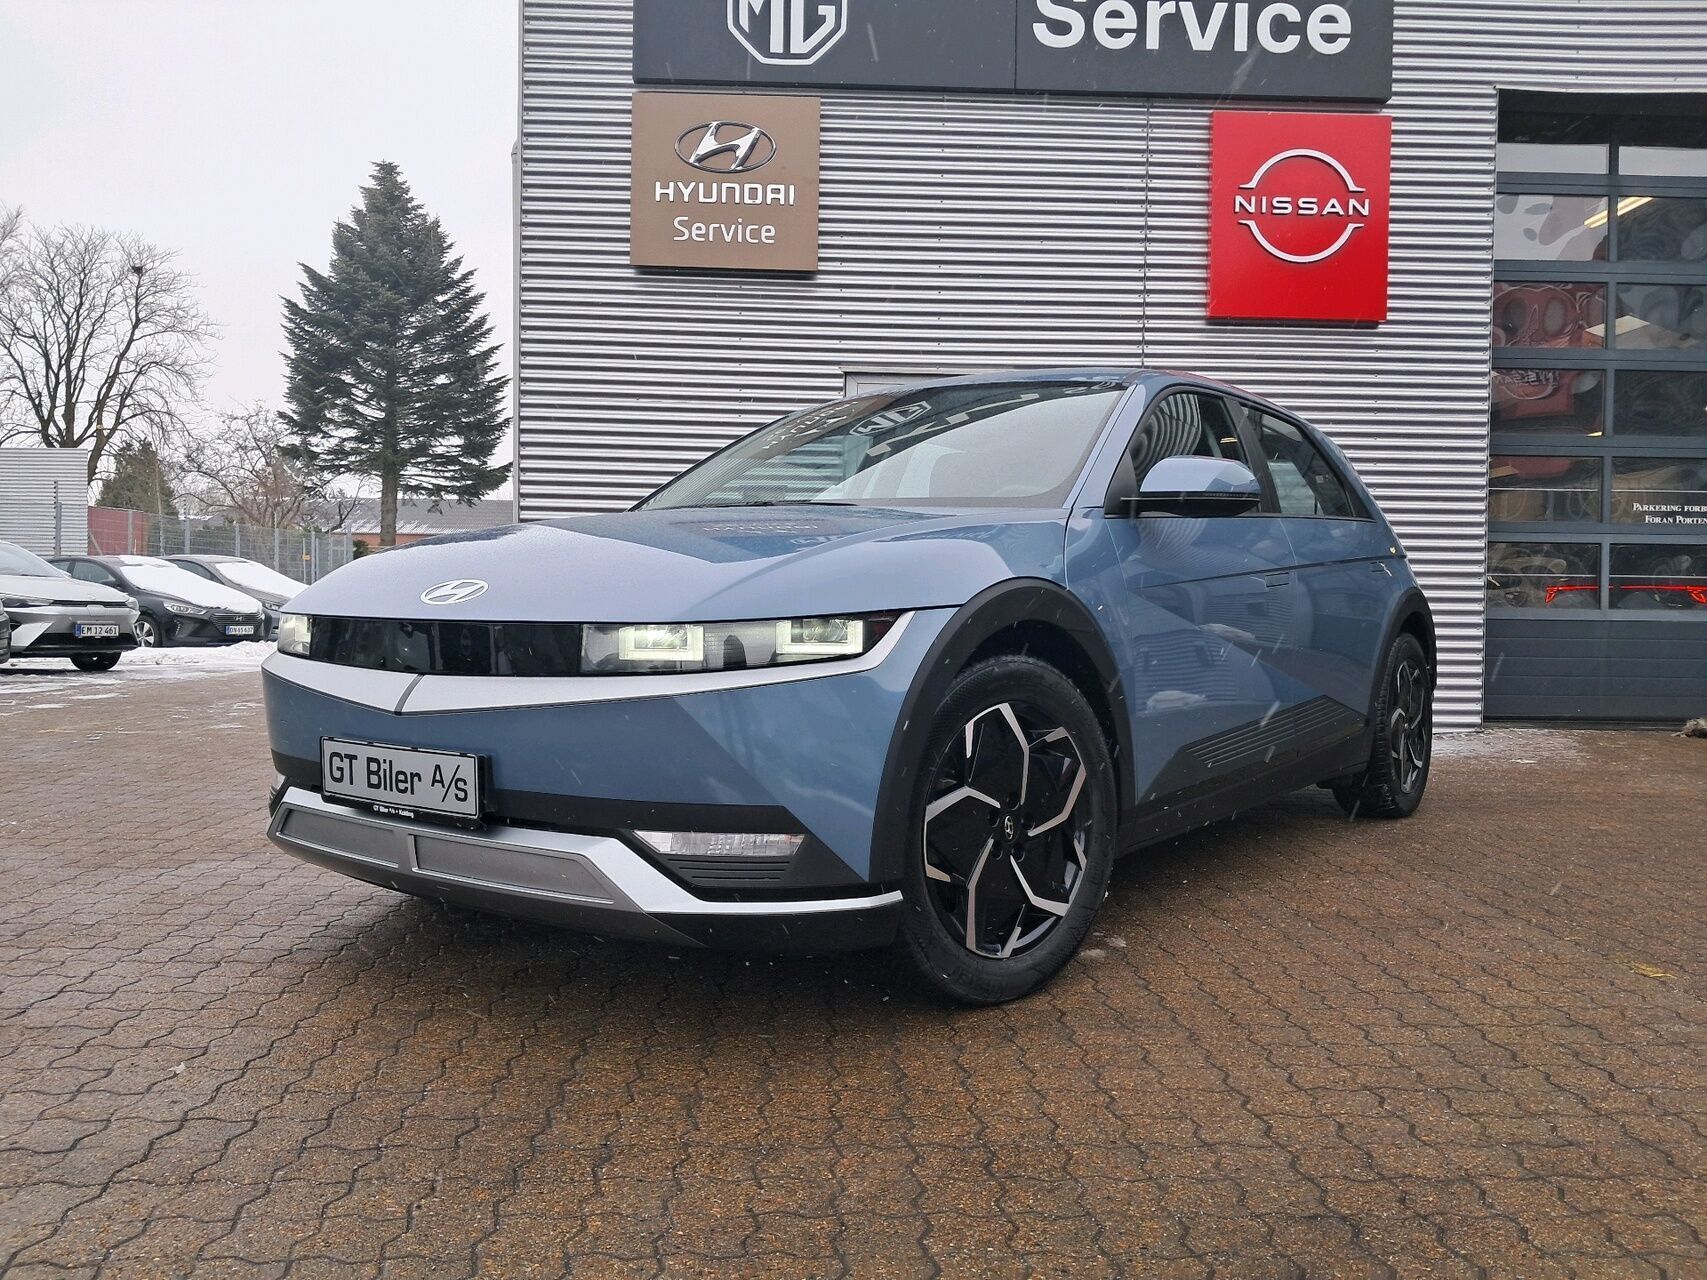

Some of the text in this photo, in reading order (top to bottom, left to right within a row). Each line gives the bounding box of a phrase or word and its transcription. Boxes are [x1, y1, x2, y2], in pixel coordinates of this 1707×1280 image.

[739, 0, 836, 54] MG
[1033, 0, 1352, 55] Service
[655, 181, 795, 205] HYUNDAI
[1234, 195, 1371, 216] NISSAN
[673, 216, 776, 244] Service
[81, 626, 117, 635] EM 12 461
[330, 751, 358, 786] GT
[364, 756, 422, 796] Biler
